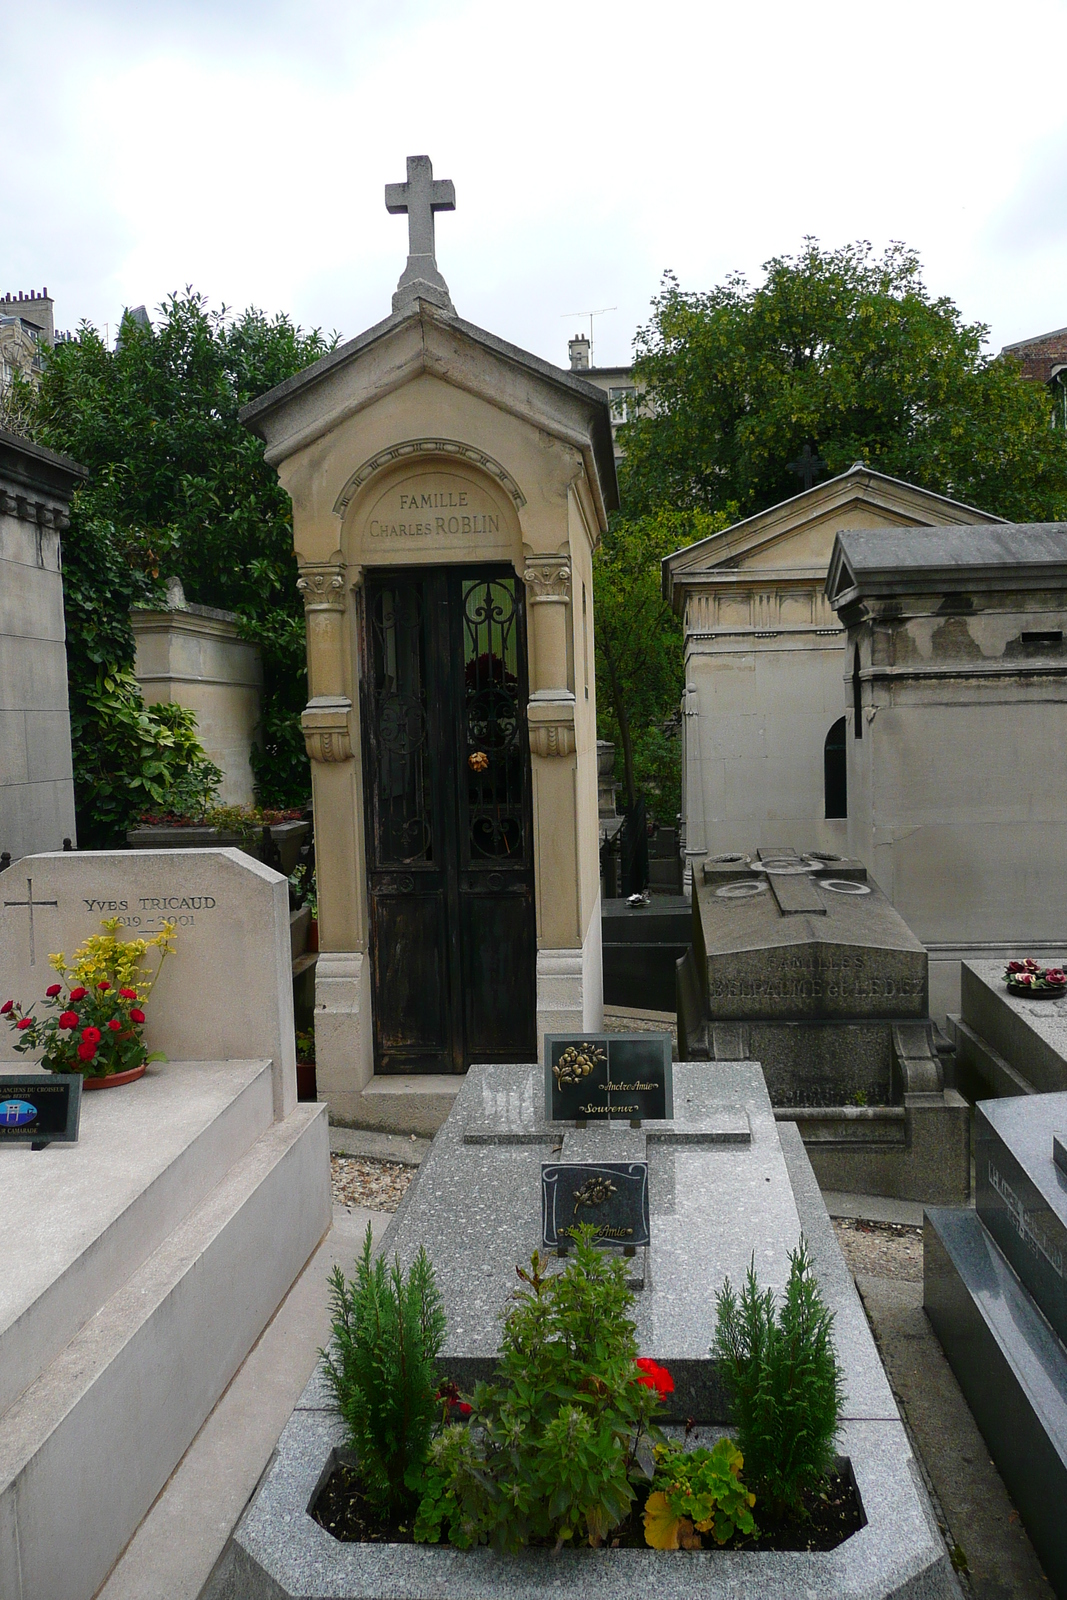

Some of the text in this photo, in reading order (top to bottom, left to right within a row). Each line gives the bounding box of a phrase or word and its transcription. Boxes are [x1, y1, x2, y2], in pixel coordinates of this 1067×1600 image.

[400, 492, 468, 509] FAMILLE
[435, 515, 500, 535] ROBLIN
[82, 896, 216, 912] YVES TRICAUD
[767, 955, 865, 971] FAMILLES
[827, 980, 849, 997] et
[584, 1103, 634, 1113] Souvenir
[599, 1224, 627, 1237] Amie
